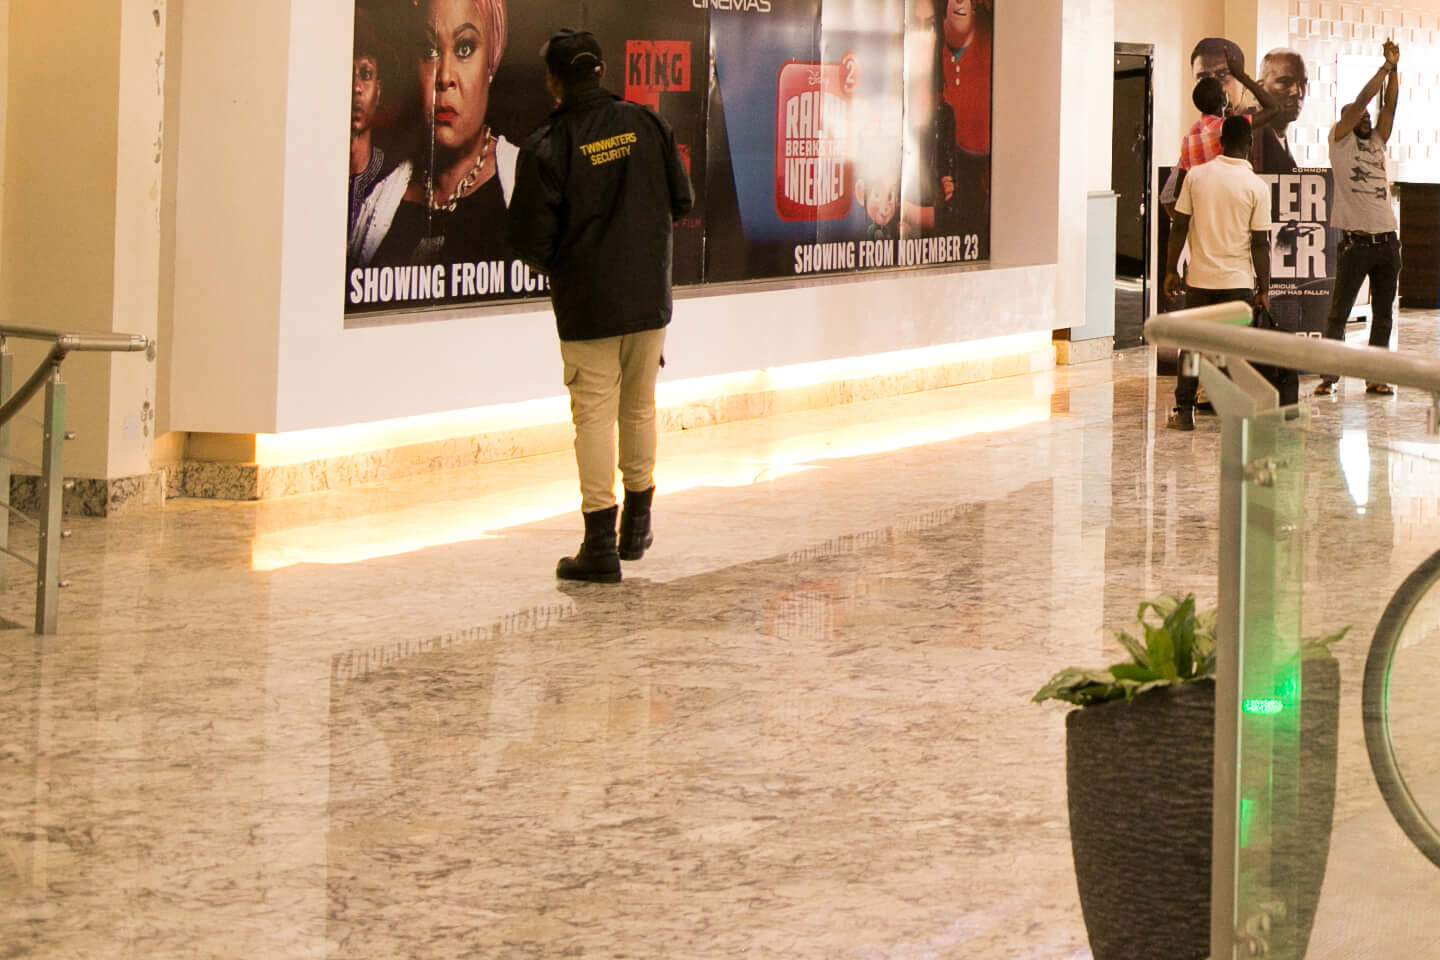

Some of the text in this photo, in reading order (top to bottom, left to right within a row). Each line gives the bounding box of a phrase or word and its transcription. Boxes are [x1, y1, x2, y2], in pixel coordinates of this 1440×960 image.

[628, 52, 683, 88] KING
[842, 55, 855, 84] 2
[580, 132, 637, 156] TWINWATERS
[590, 145, 632, 166] SECURITY
[784, 157, 845, 207] INTERNET
[794, 233, 980, 274] SHOWING FROM NOVEMBER 23
[350, 259, 551, 304] SHOWING FROM OC
